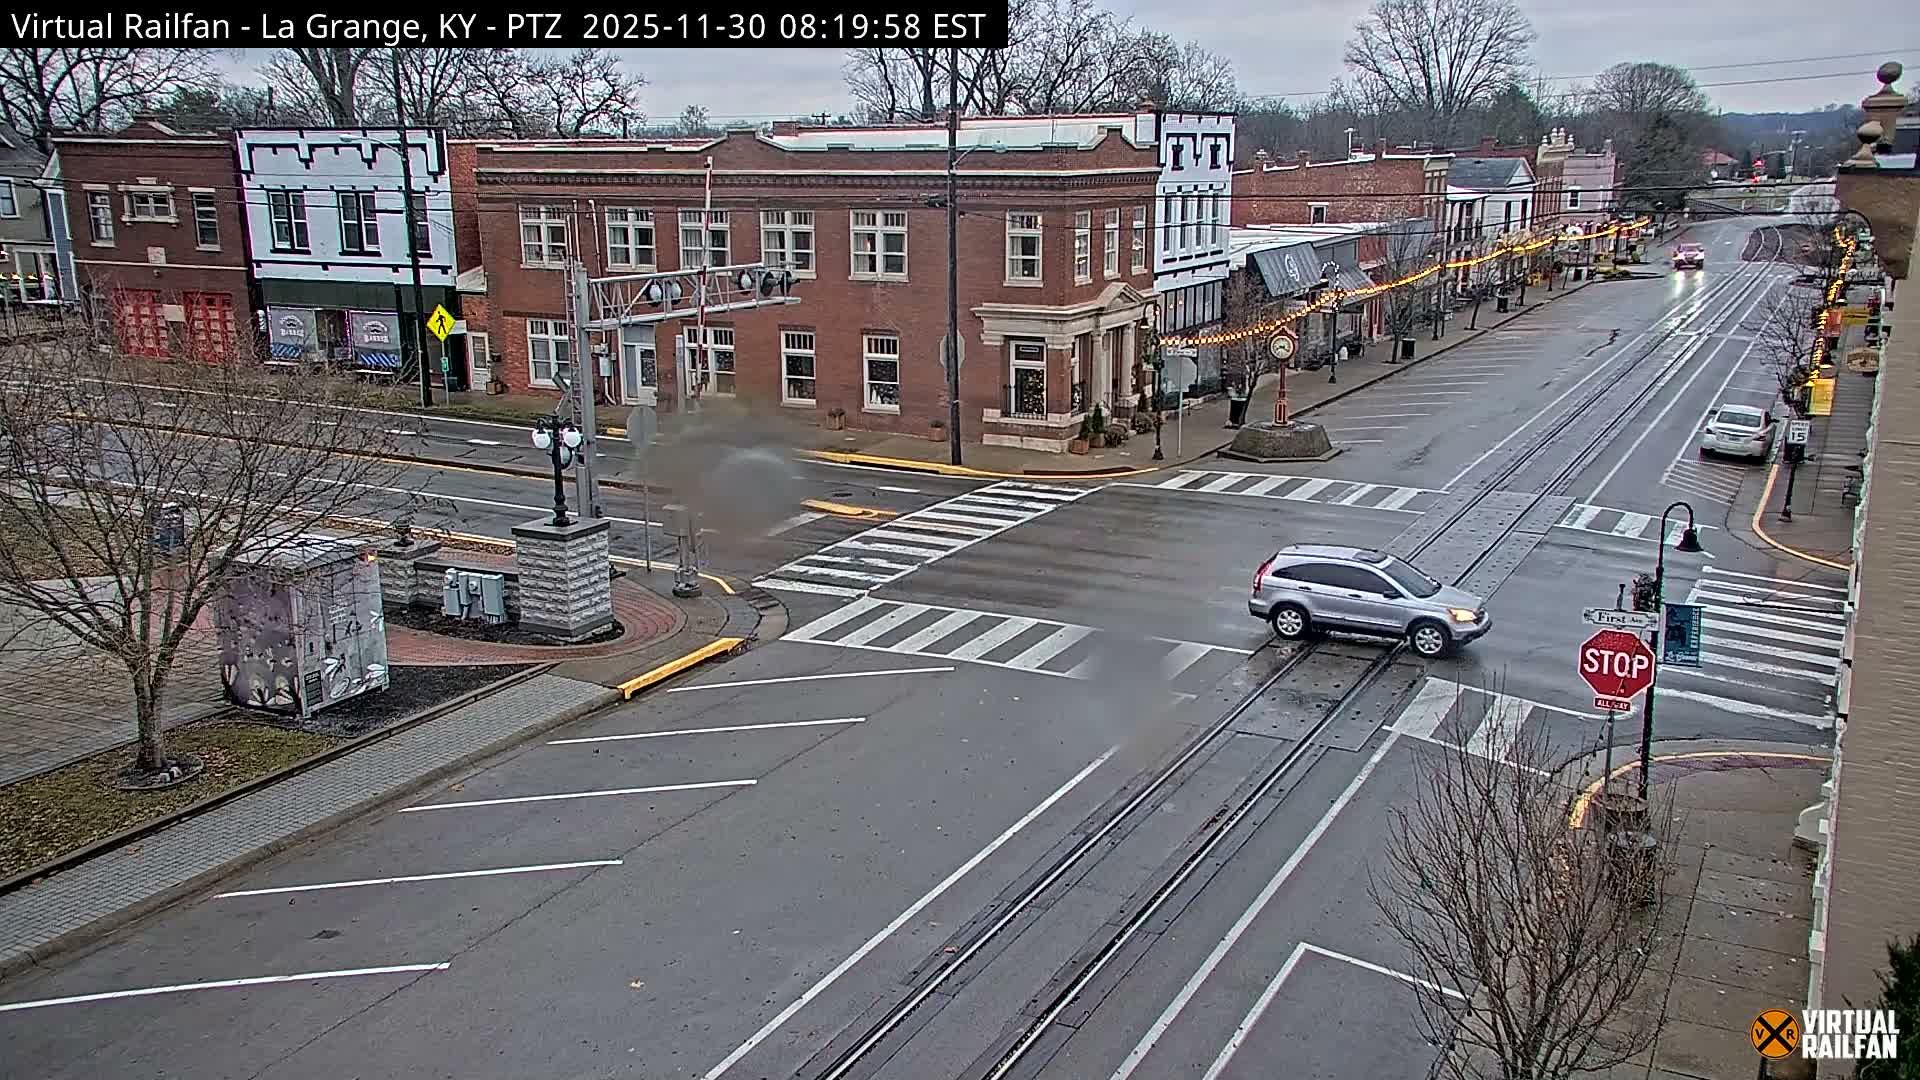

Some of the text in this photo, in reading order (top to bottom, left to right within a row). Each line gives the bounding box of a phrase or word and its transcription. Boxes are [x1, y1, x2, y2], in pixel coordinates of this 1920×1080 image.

[1792, 431, 1805, 441] 15
[1598, 611, 1626, 623] First
[1583, 648, 1649, 679] STOP
[1597, 699, 1610, 707] ALL
